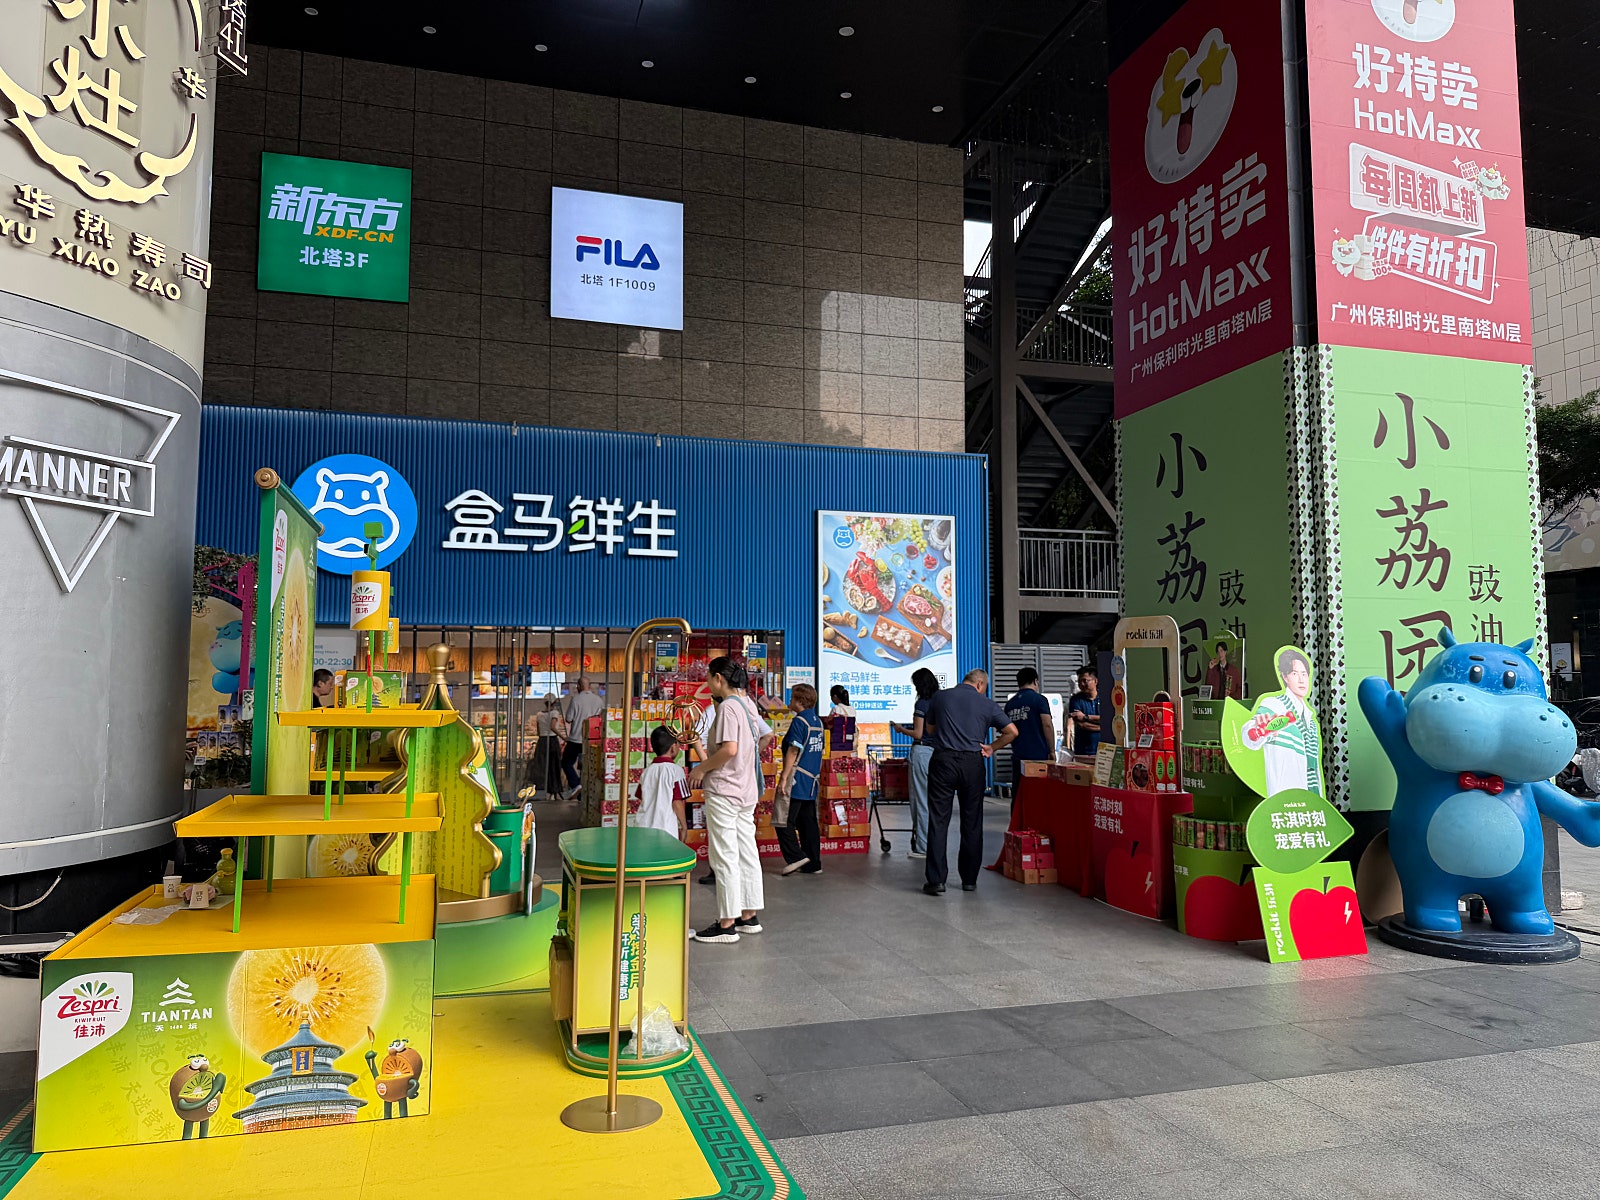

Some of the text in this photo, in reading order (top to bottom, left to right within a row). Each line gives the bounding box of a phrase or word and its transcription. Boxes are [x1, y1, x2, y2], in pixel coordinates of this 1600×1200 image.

[1352, 42, 1479, 111] 好特卖
[1361, 153, 1480, 226] 每周都上新
[267, 183, 403, 236] 新东方
[315, 226, 394, 243] XDF.CN
[1127, 152, 1267, 297] 好特卖
[299, 246, 369, 268] 北塔3F
[576, 235, 660, 271] FILA
[1370, 225, 1487, 292] 件件有折扣
[53, 237, 120, 276] XIAO
[133, 269, 181, 300] ZAO
[580, 273, 657, 292] 北塔 1F1009
[1330, 301, 1521, 342] 广州保利时光里南塔M层
[1130, 298, 1272, 384] 广州保利时光里南塔M层
[0, 446, 131, 503] MANNER
[442, 489, 679, 558] 盒马鲜生
[830, 671, 880, 683] 来盒马鲜生
[873, 684, 912, 696] 乐享生活
[1093, 796, 1123, 817] 乐淇时刻
[1093, 813, 1124, 834] 宠爱有礼
[1270, 809, 1327, 830] 乐淇时刻
[1274, 830, 1331, 850] 宠爱有礼
[1269, 911, 1286, 955] rockit
[57, 995, 122, 1019] Zespri
[141, 1008, 213, 1023] TIANTAN
[73, 1023, 106, 1039] 佳沛
[154, 1024, 165, 1032] 天
